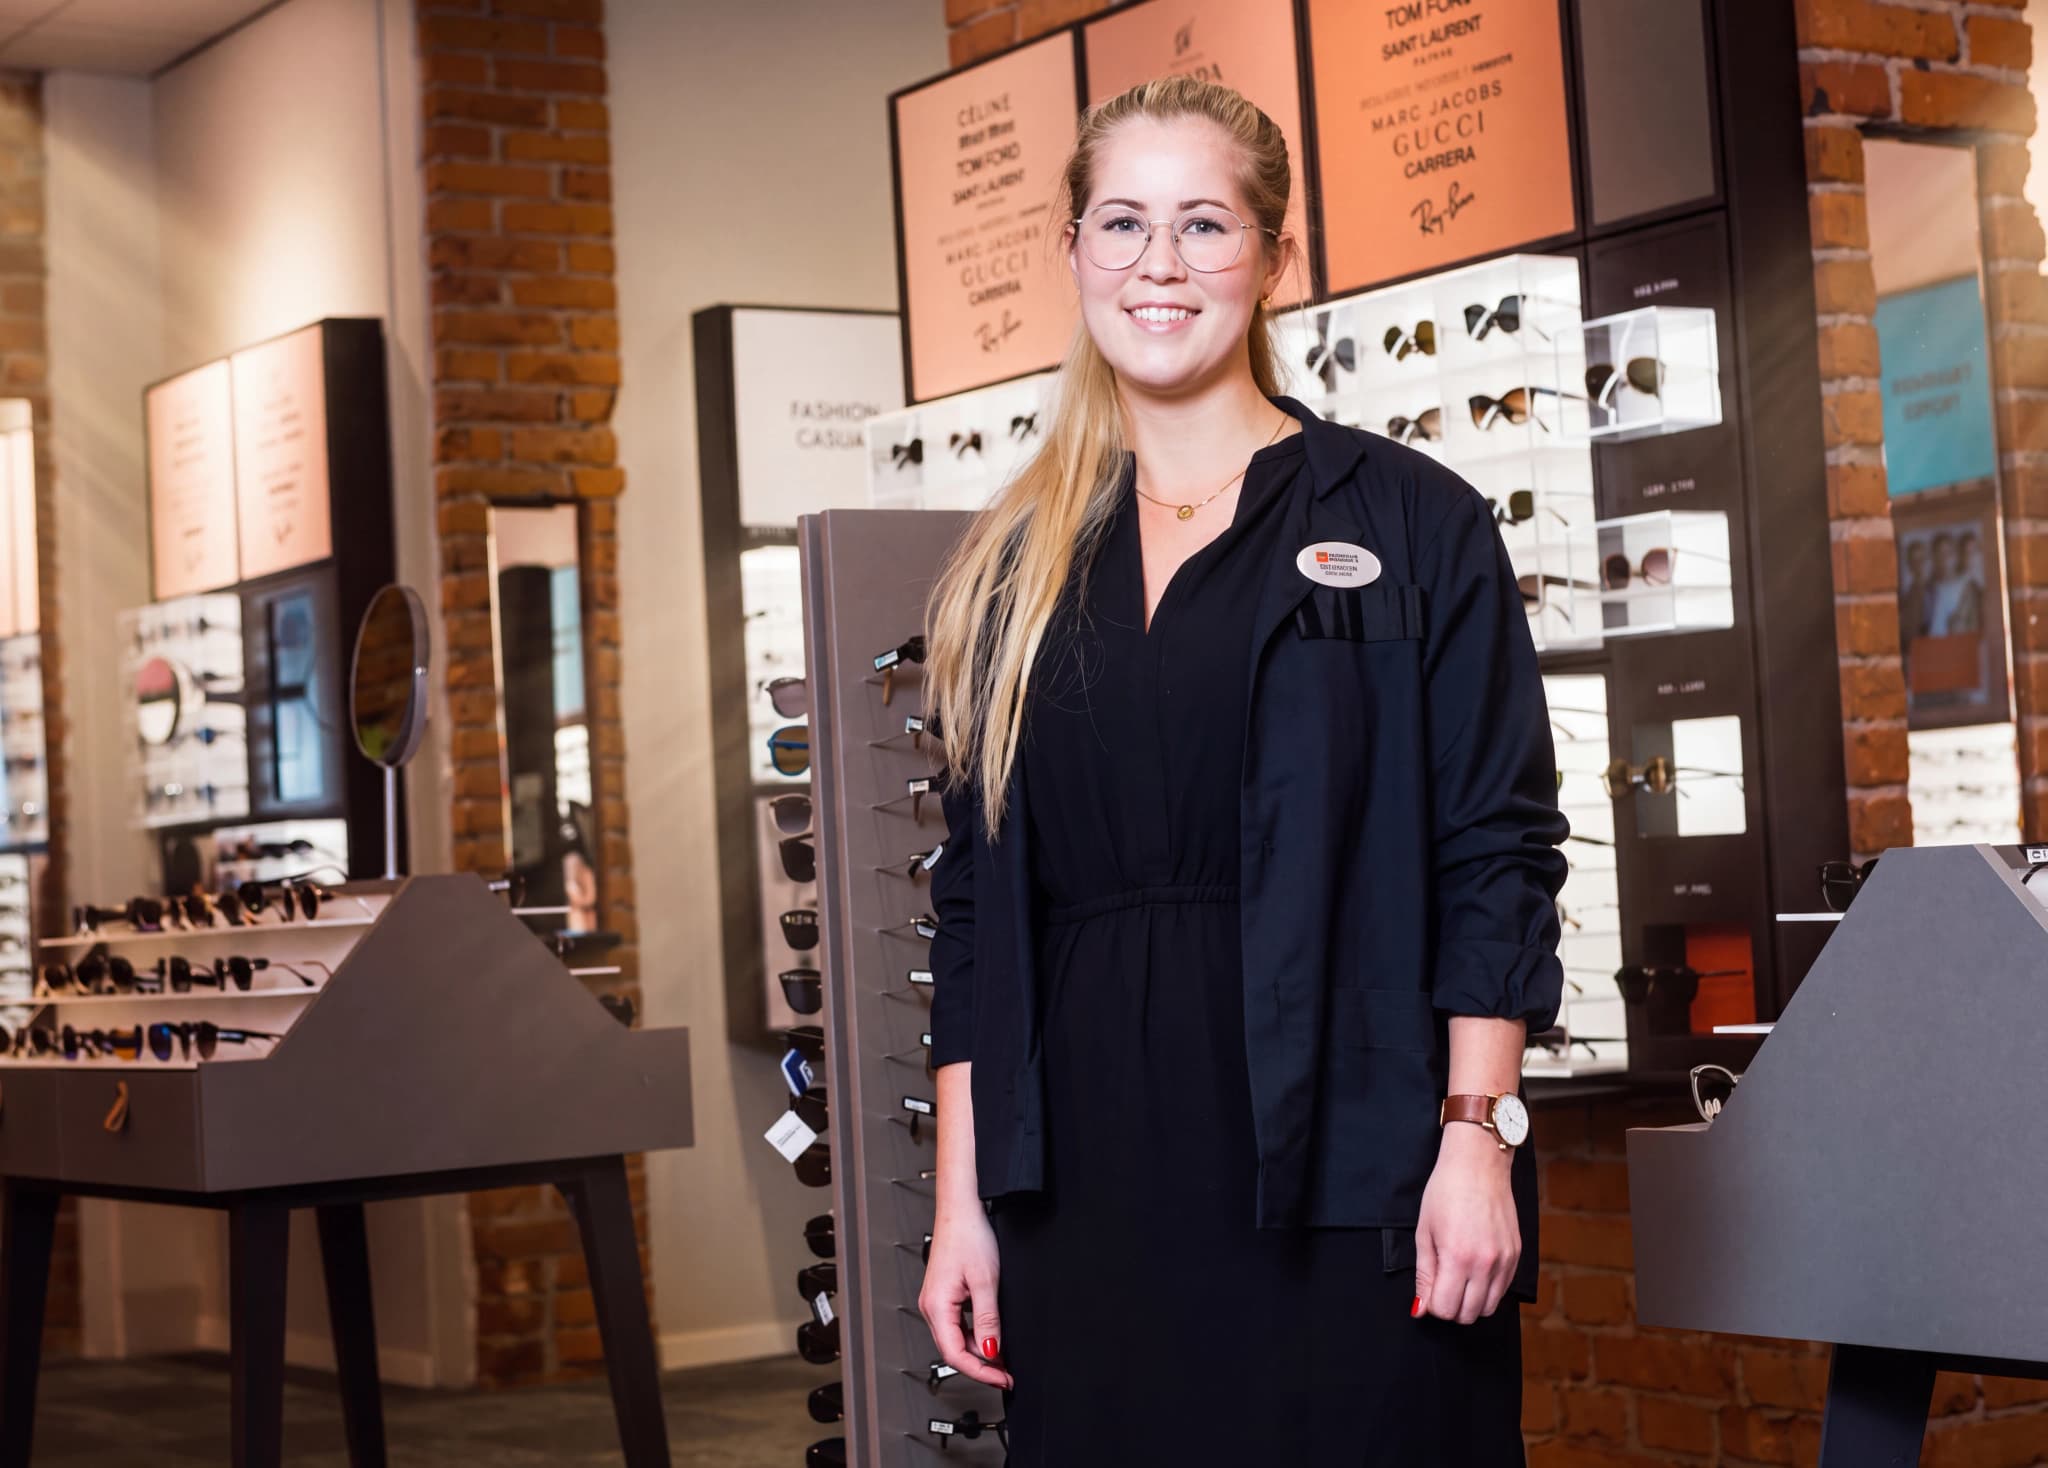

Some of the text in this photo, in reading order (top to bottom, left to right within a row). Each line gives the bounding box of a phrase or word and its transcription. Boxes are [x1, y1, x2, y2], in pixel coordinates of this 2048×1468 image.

[1385, 0, 1472, 29] TOM FO
[1382, 35, 1417, 61] SAINT
[1420, 13, 1482, 47] LAURENT
[1371, 104, 1421, 132] MARC
[1430, 79, 1502, 116] JACOBS
[1393, 109, 1484, 157] GUCCI
[1404, 145, 1476, 178] CARRERA
[960, 249, 1029, 288] GUCCI
[790, 400, 880, 421] FASHION
